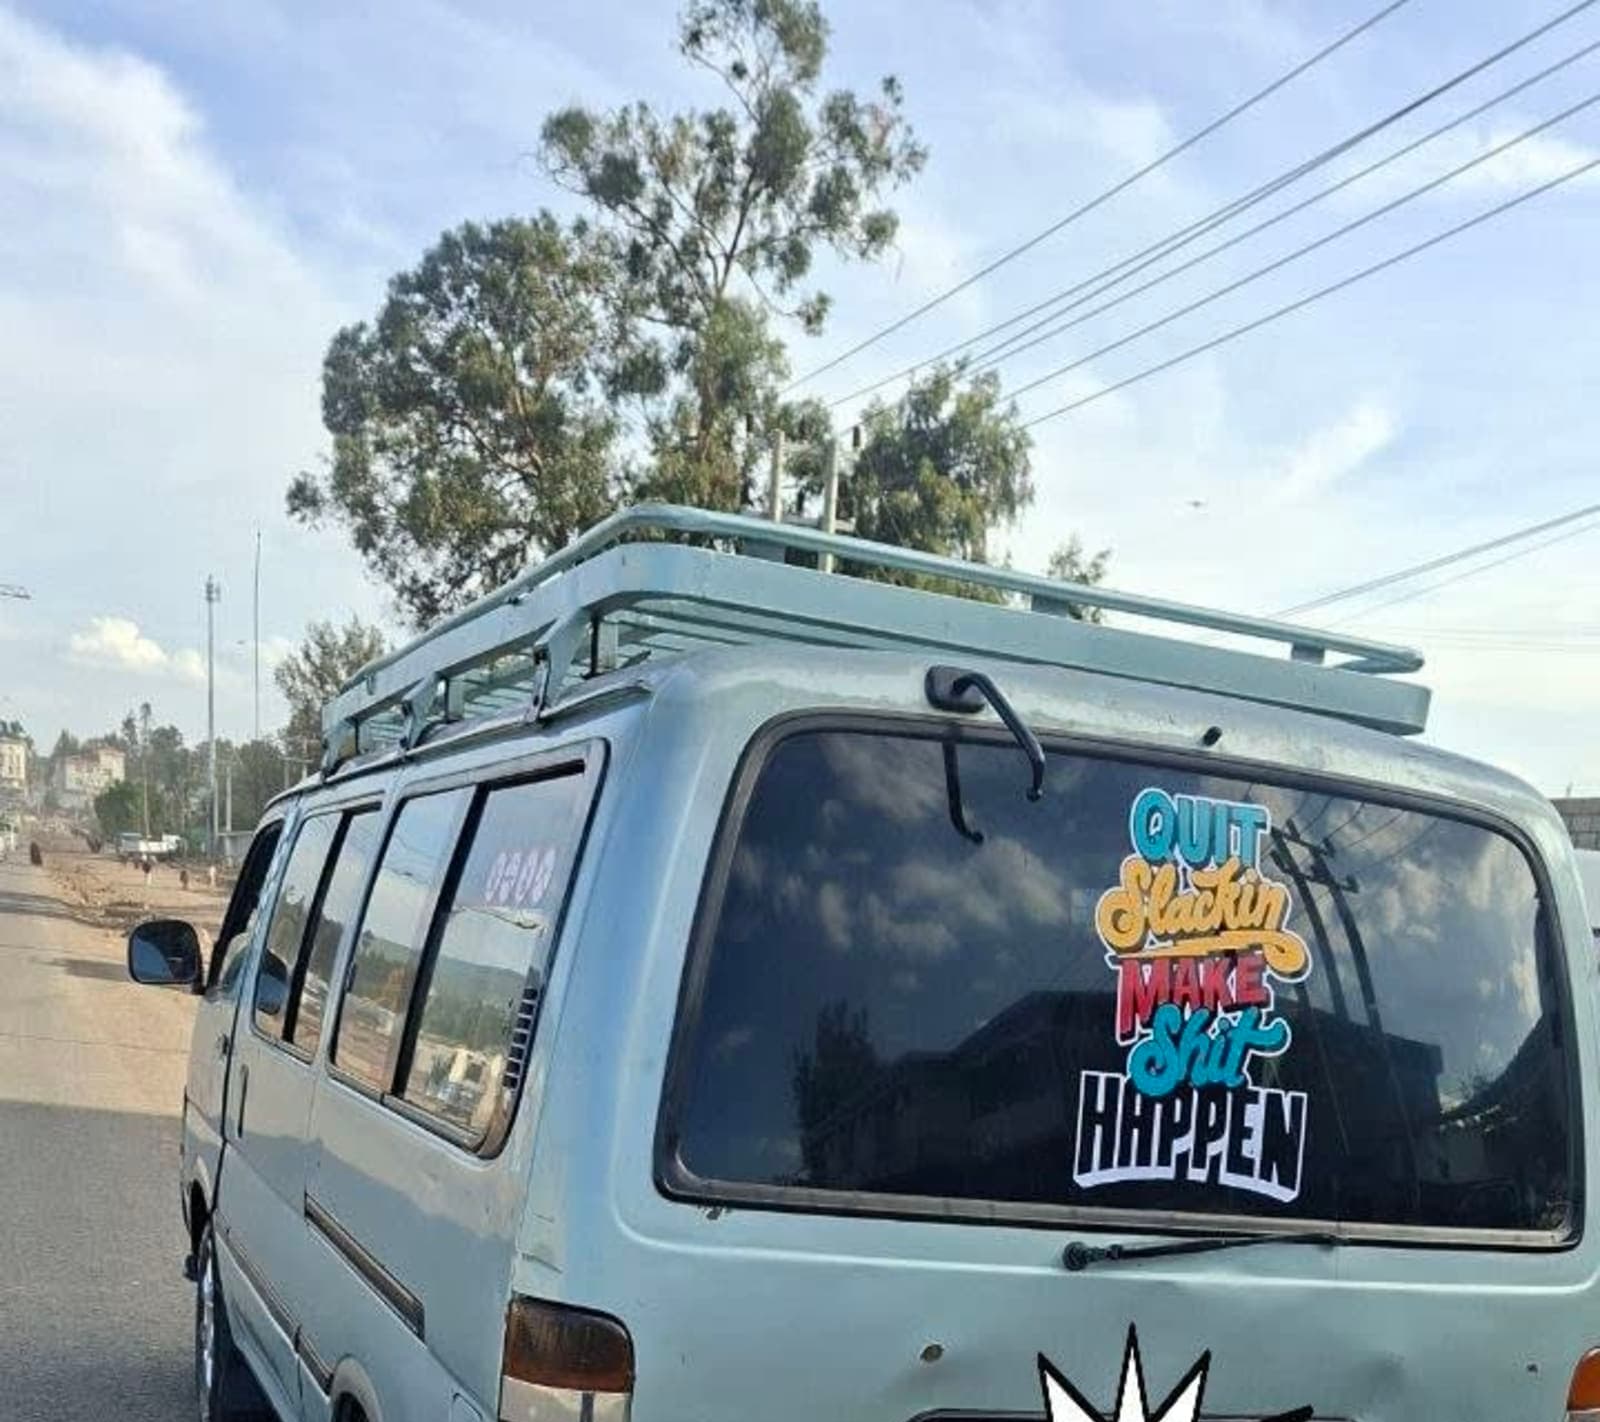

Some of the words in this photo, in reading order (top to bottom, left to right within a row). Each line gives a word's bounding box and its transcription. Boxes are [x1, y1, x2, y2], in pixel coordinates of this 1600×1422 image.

[1131, 788, 1271, 869] QUIT
[1096, 854, 1311, 982] Slackin
[1117, 953, 1275, 1046] MAKE
[1128, 1003, 1291, 1098] Shit
[1073, 1071, 1308, 1202] HAPPEN
